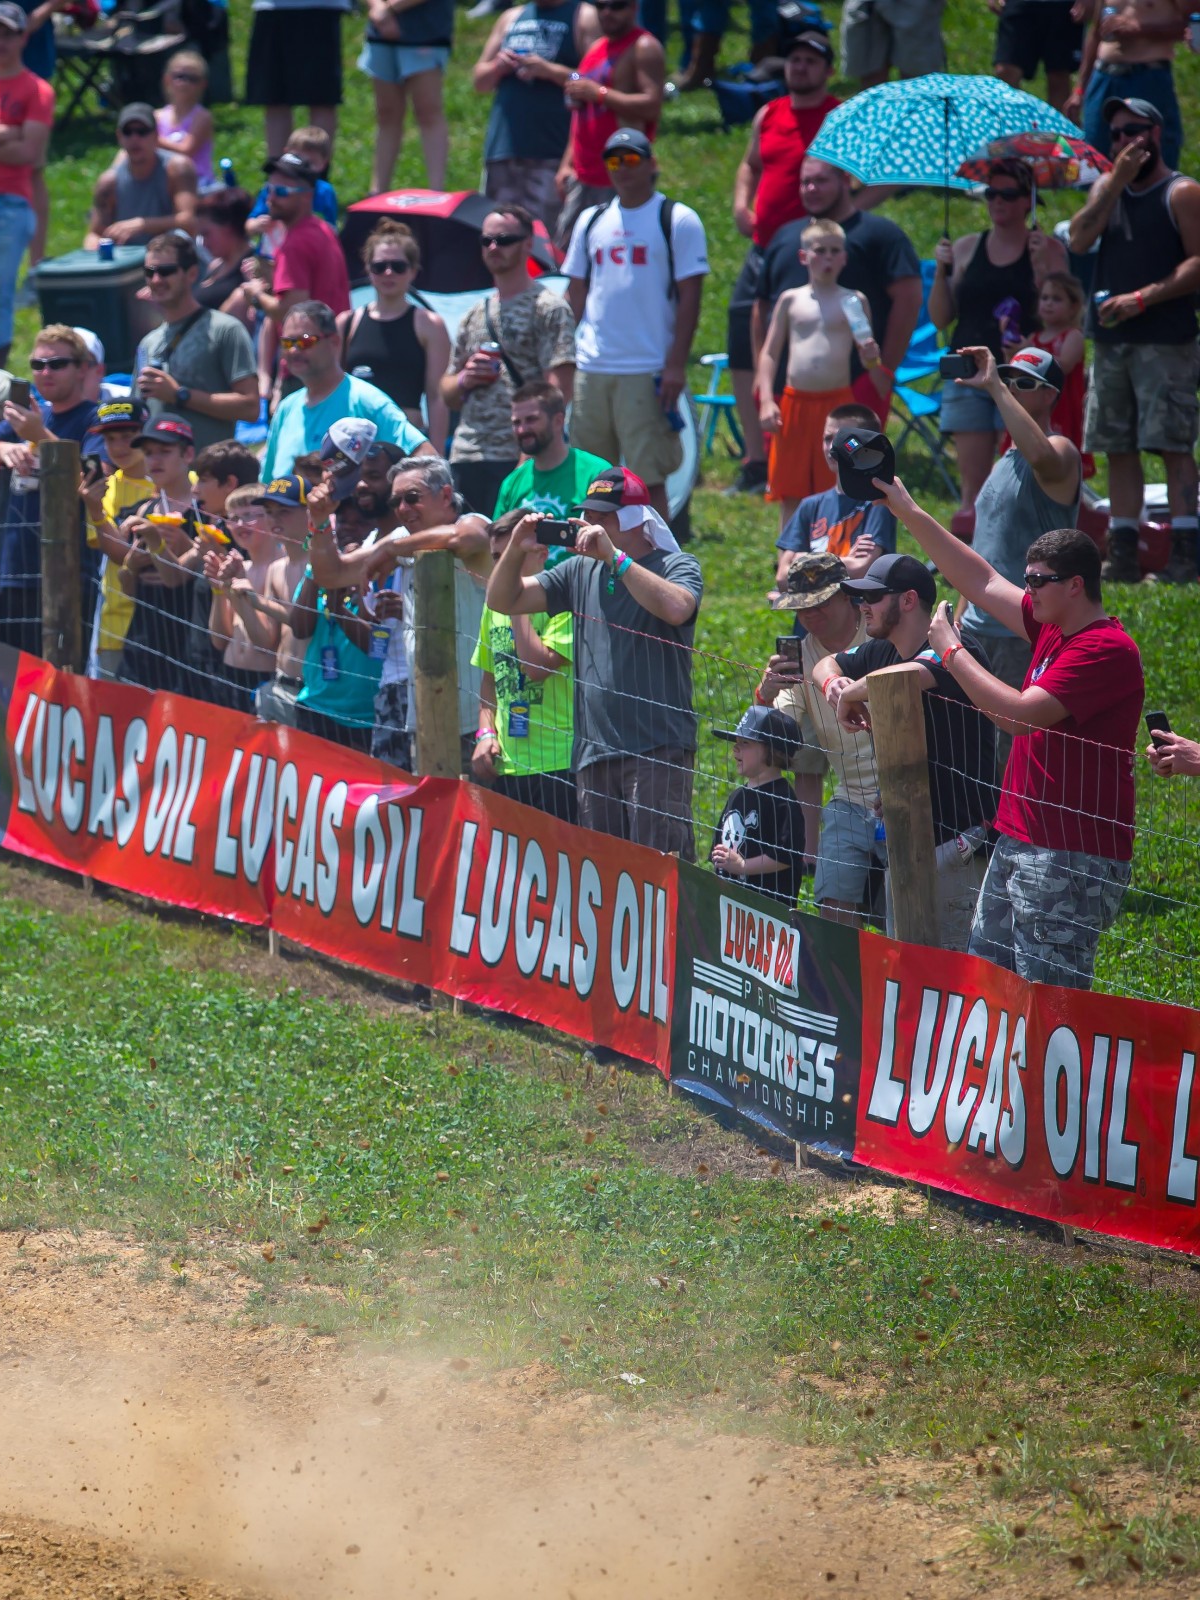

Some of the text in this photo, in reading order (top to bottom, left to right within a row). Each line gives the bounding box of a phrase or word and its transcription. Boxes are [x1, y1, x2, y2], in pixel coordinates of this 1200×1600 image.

[14, 692, 207, 865] LUCAS OIL
[214, 748, 424, 942] LUCAS OIL
[450, 820, 668, 1025] LUCAS OIL
[723, 902, 796, 990] LUCAS OIL
[688, 986, 838, 1104] MOTOCROSS
[744, 980, 778, 1017] PRO
[687, 1049, 834, 1131] CHAMPIONSHIP
[865, 977, 1028, 1172] LUCAS
[1043, 1023, 1140, 1193] OIL
